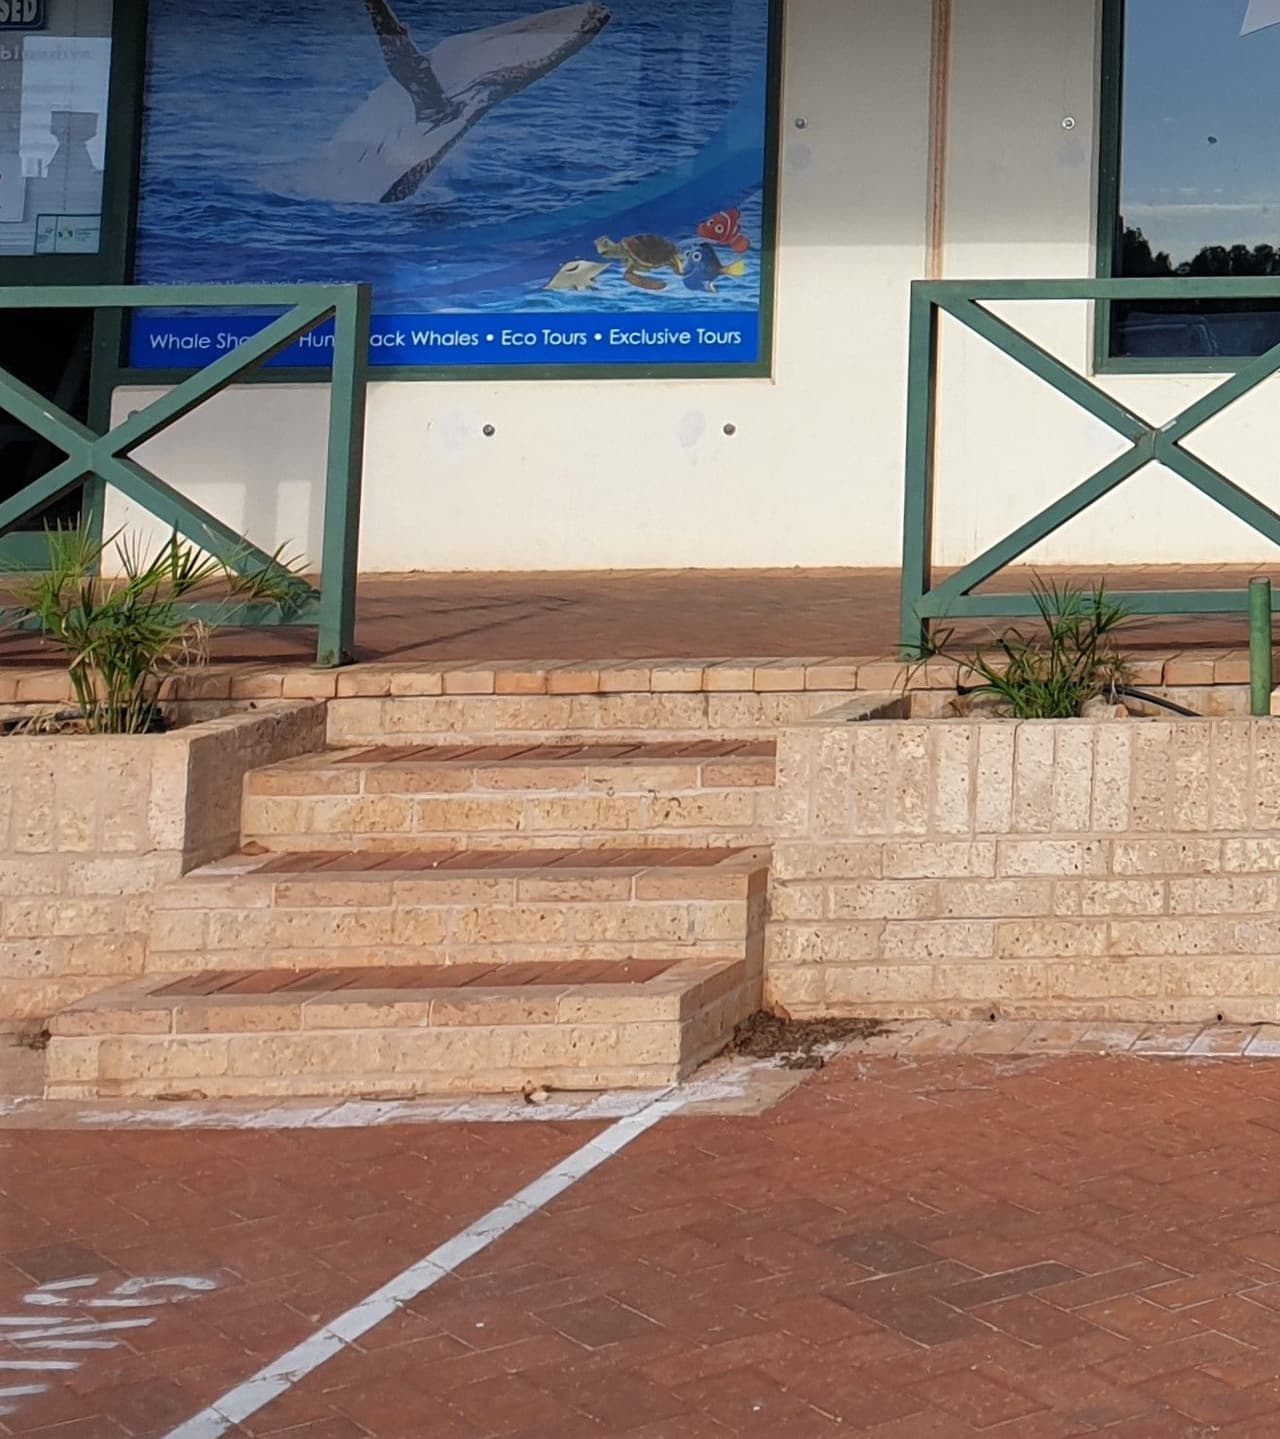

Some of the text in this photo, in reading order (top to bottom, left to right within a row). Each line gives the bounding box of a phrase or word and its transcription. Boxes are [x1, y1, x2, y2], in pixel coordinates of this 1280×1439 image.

[150, 333, 211, 349] Whale
[216, 332, 250, 349] Sha
[411, 330, 480, 347] Whales
[501, 329, 538, 346] Eco
[542, 329, 588, 345] Tours
[609, 328, 691, 345] Exclusive
[696, 328, 742, 345] Tours
